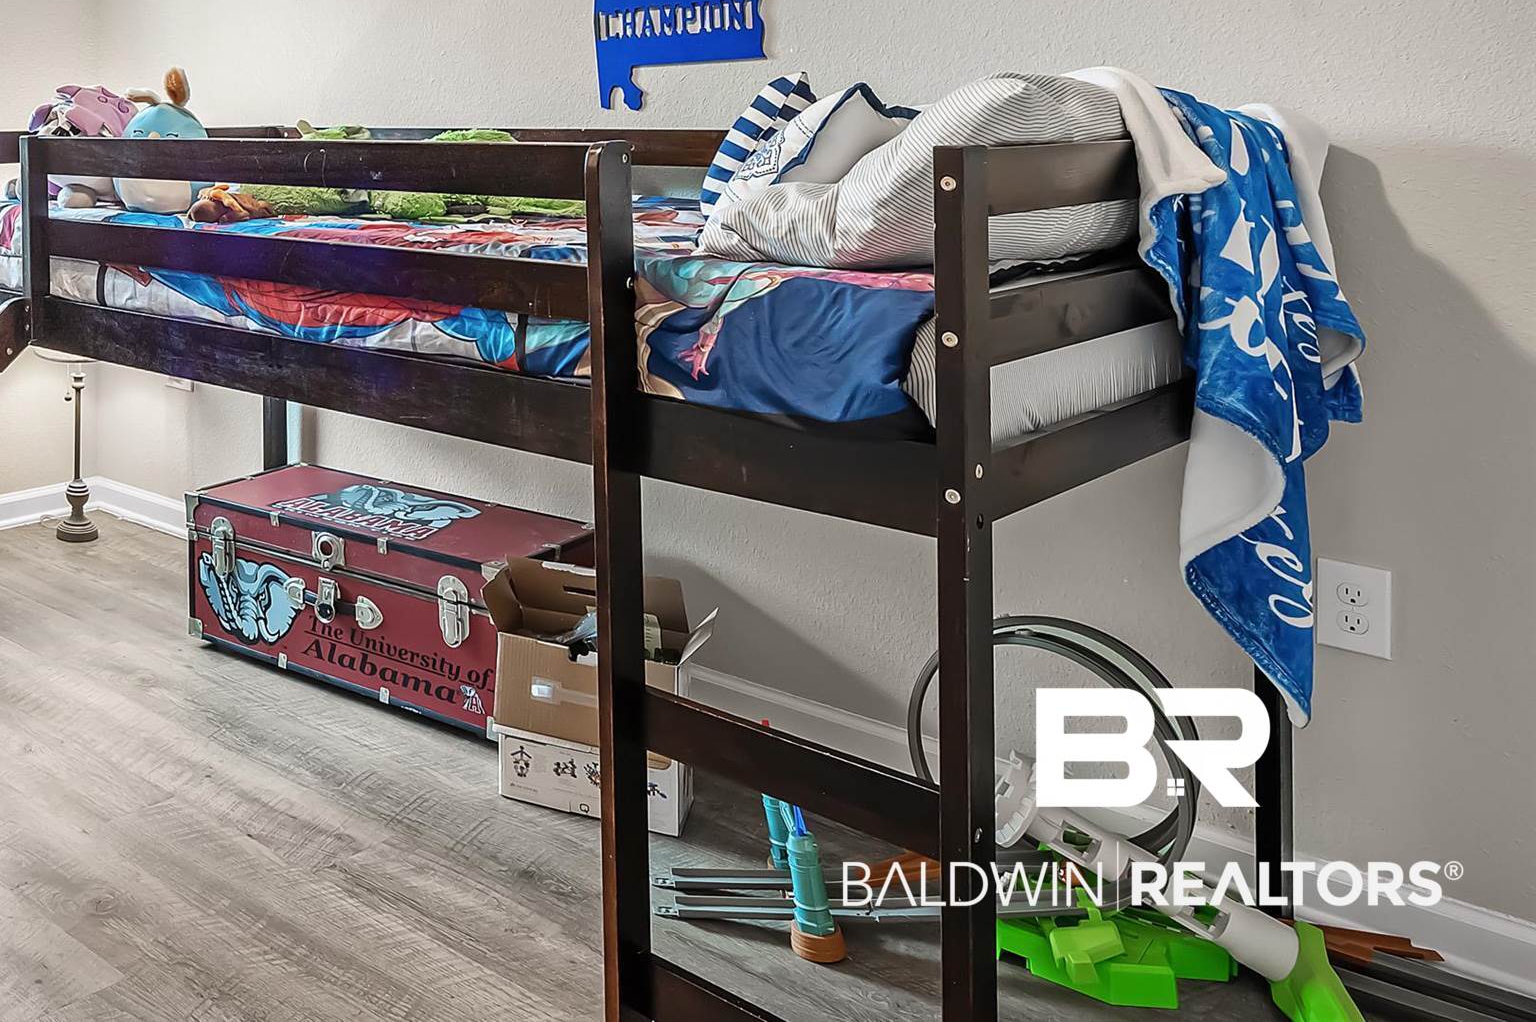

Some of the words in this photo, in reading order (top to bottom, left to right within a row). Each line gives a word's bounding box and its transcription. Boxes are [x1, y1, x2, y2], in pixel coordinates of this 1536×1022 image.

[272, 497, 440, 540] ALABAMA
[302, 637, 457, 704] Alabama
[349, 627, 461, 680] University
[467, 668, 494, 690] of
